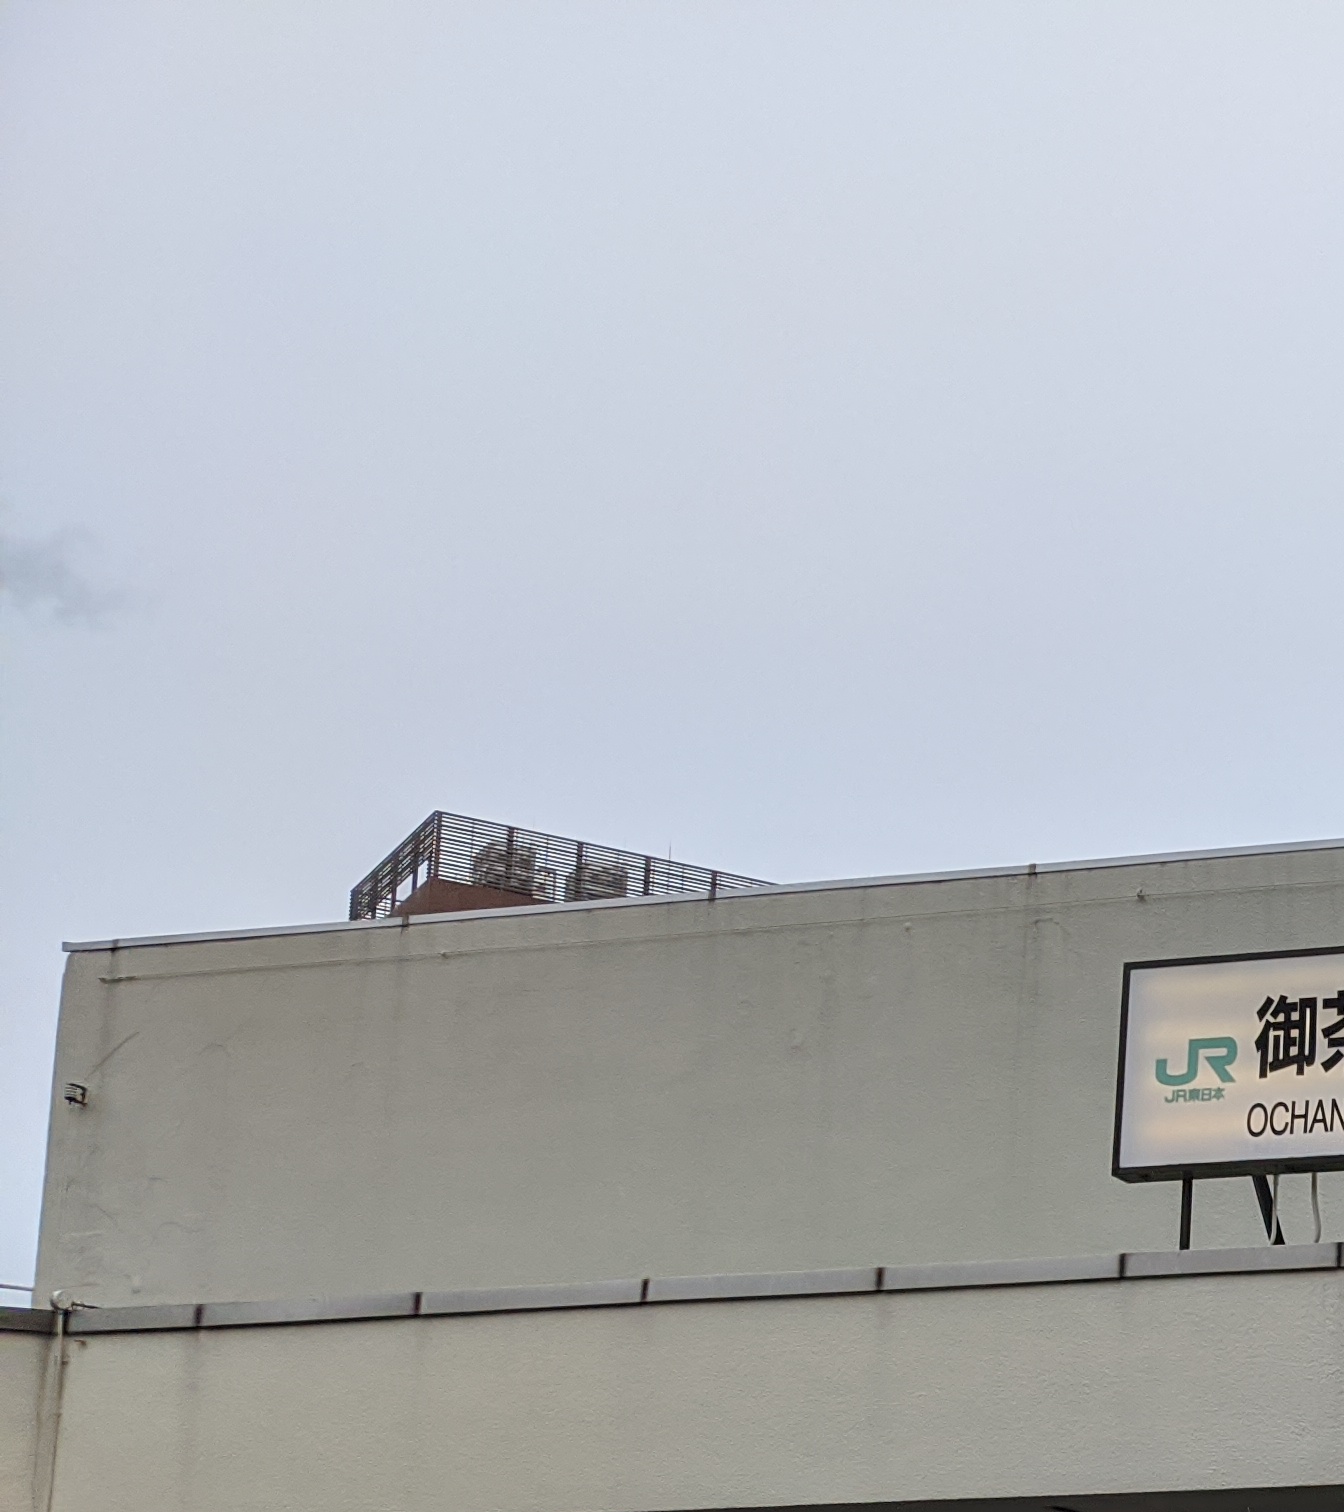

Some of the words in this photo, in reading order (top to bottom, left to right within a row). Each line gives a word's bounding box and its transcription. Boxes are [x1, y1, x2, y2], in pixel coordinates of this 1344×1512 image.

[1155, 1036, 1238, 1087] JR
[1164, 1087, 1225, 1104] JR東日本
